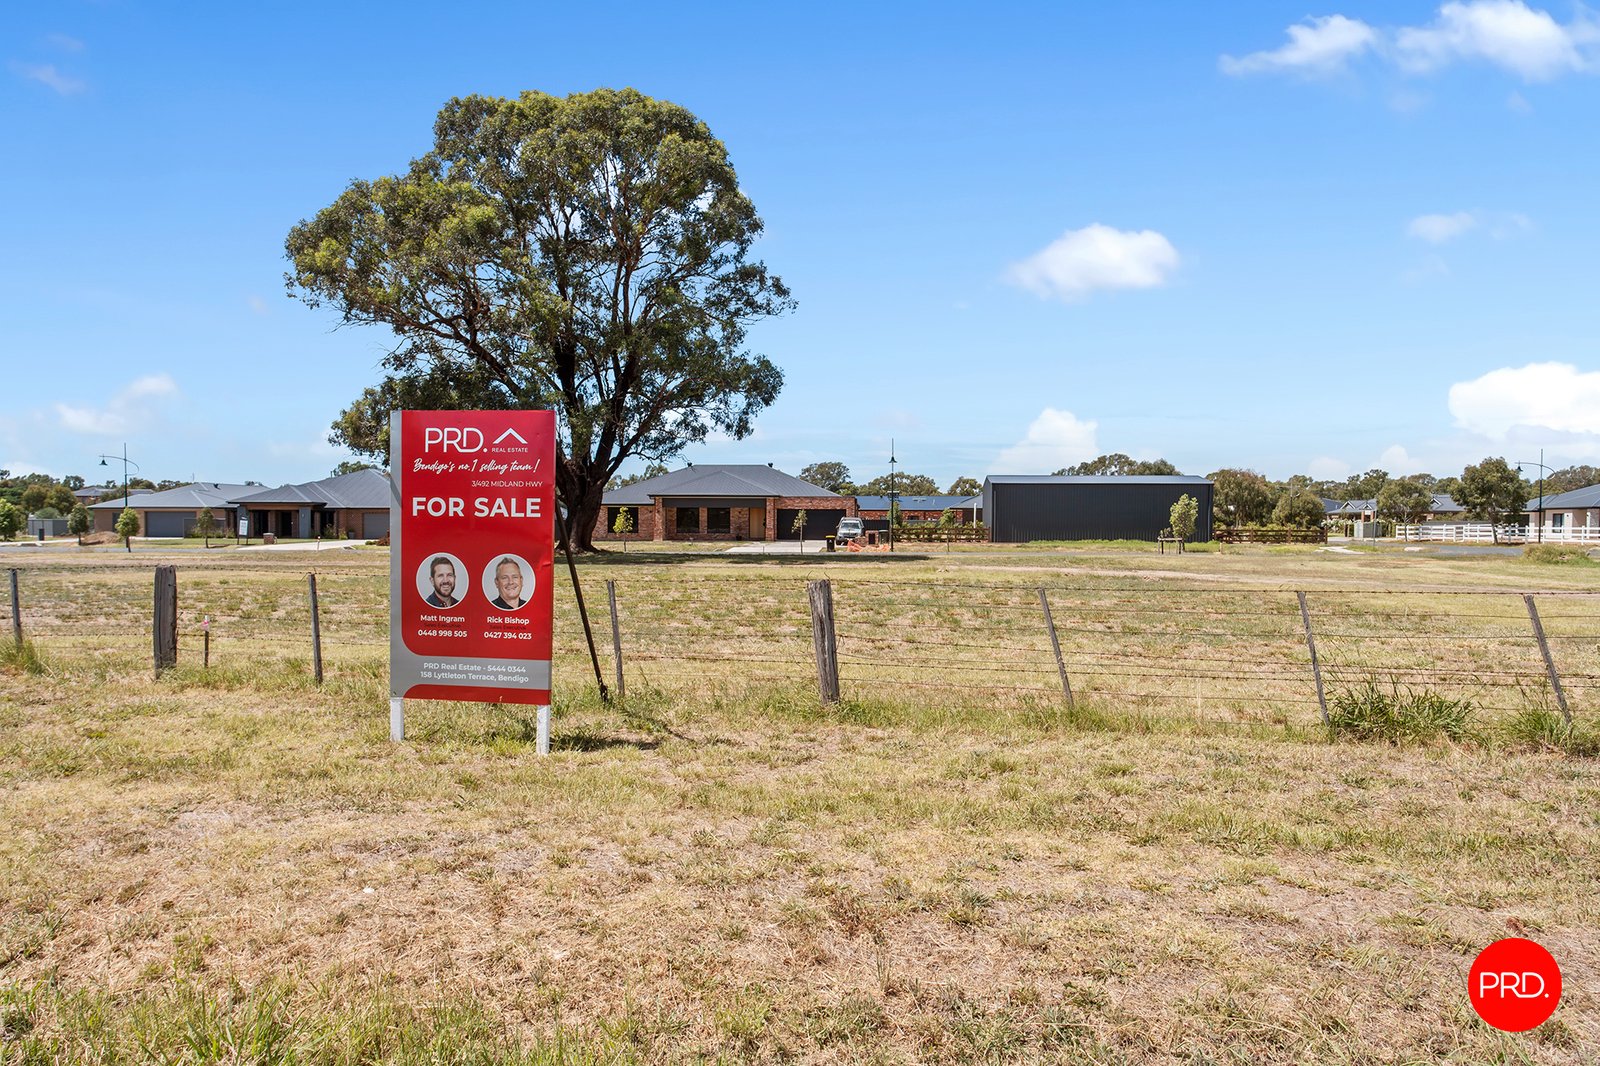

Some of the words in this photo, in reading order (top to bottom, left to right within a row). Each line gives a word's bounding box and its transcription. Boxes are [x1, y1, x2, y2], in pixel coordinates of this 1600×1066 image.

[413, 457, 456, 475] Bendigo's
[479, 459, 508, 475] selling
[471, 480, 490, 488] 3/492
[490, 480, 525, 488] MIDLAND
[412, 497, 465, 517] FOR
[474, 497, 542, 518] SALE
[420, 614, 438, 622] Matt
[438, 615, 465, 623] Ingram
[487, 616, 503, 624] Rick
[504, 616, 530, 625] Bishop
[453, 630, 468, 638] 505
[483, 631, 502, 639] 0427
[518, 632, 532, 640] 023
[423, 662, 440, 670] PRD
[458, 663, 482, 671] Estate
[487, 664, 506, 672] 5444
[507, 665, 527, 673] 0344
[433, 671, 467, 680] Lyttleton
[467, 673, 497, 681] Terrace,
[498, 674, 529, 684] Bendigo
